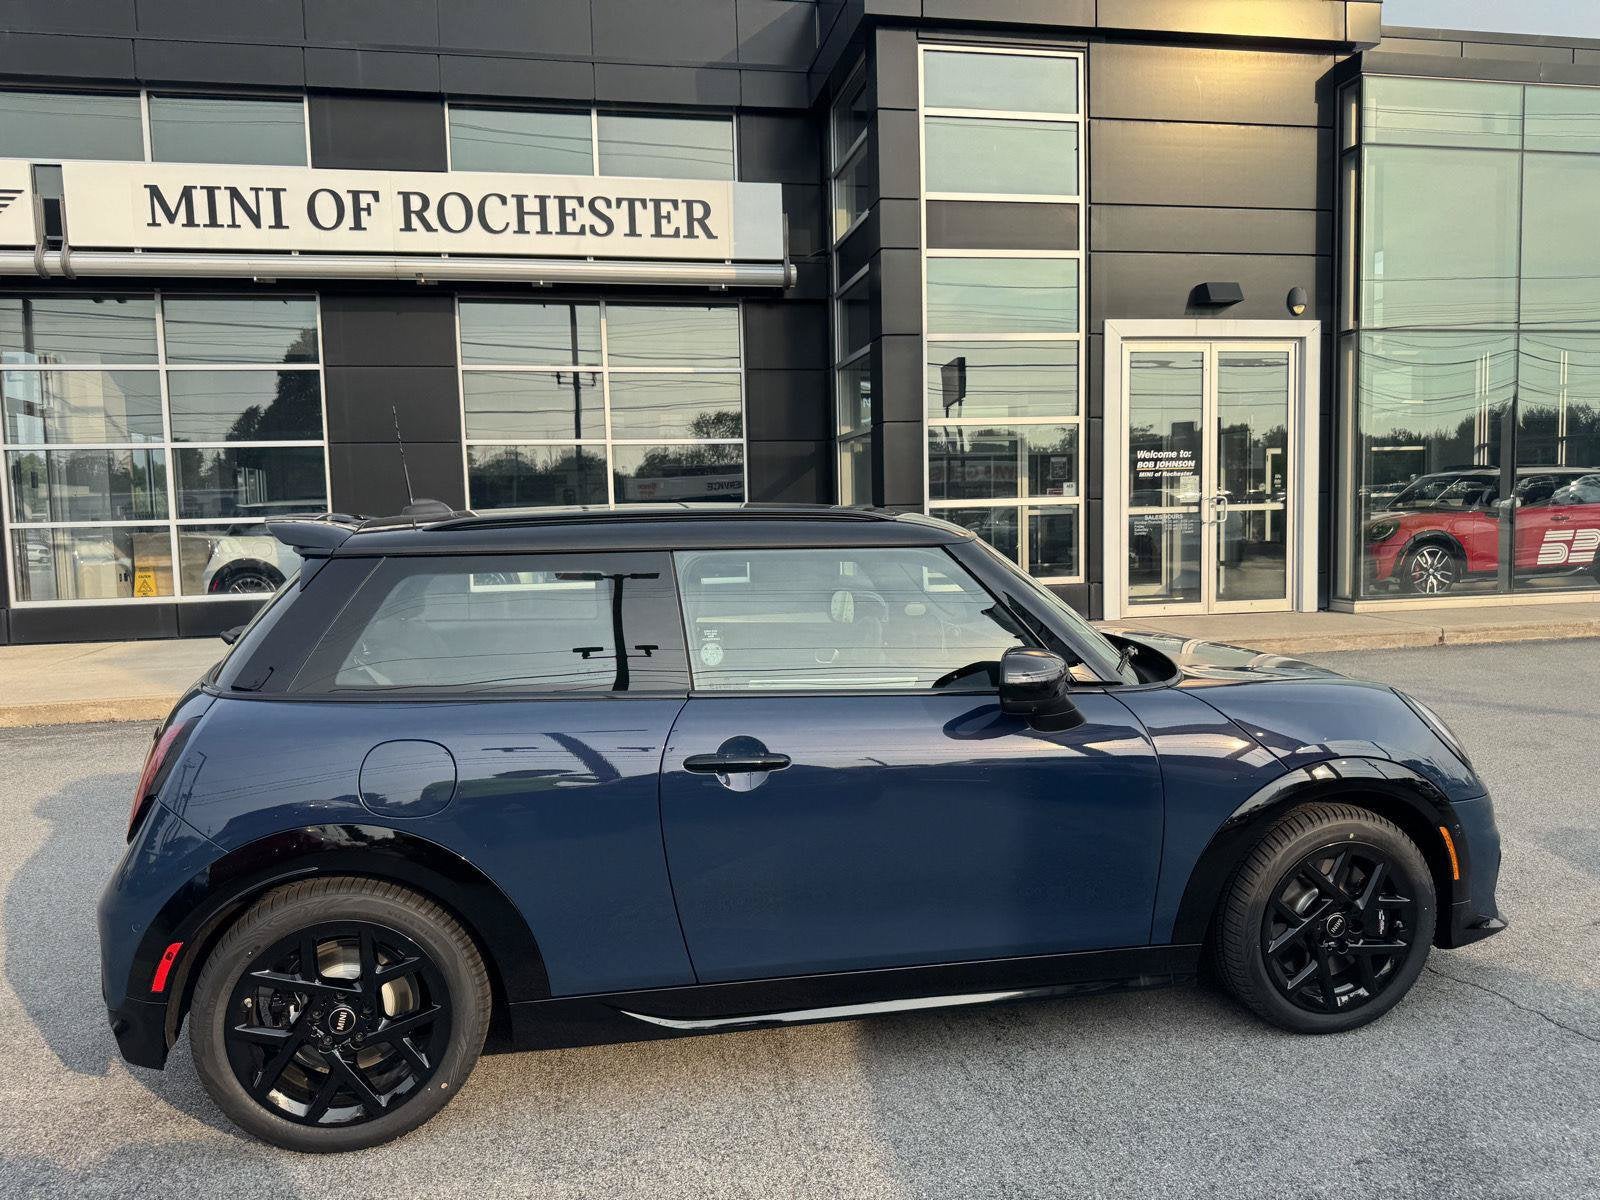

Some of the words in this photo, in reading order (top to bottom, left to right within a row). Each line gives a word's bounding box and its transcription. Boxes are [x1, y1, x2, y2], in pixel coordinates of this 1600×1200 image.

[143, 184, 290, 230] MINI
[306, 187, 380, 232] OF
[397, 190, 719, 240] ROCHESTER
[1136, 450, 1178, 459] Welcome
[1179, 449, 1192, 458] to:
[1136, 460, 1155, 469] BOB
[1155, 460, 1195, 469] JOHNSON
[336, 1011, 348, 1031] MINI
